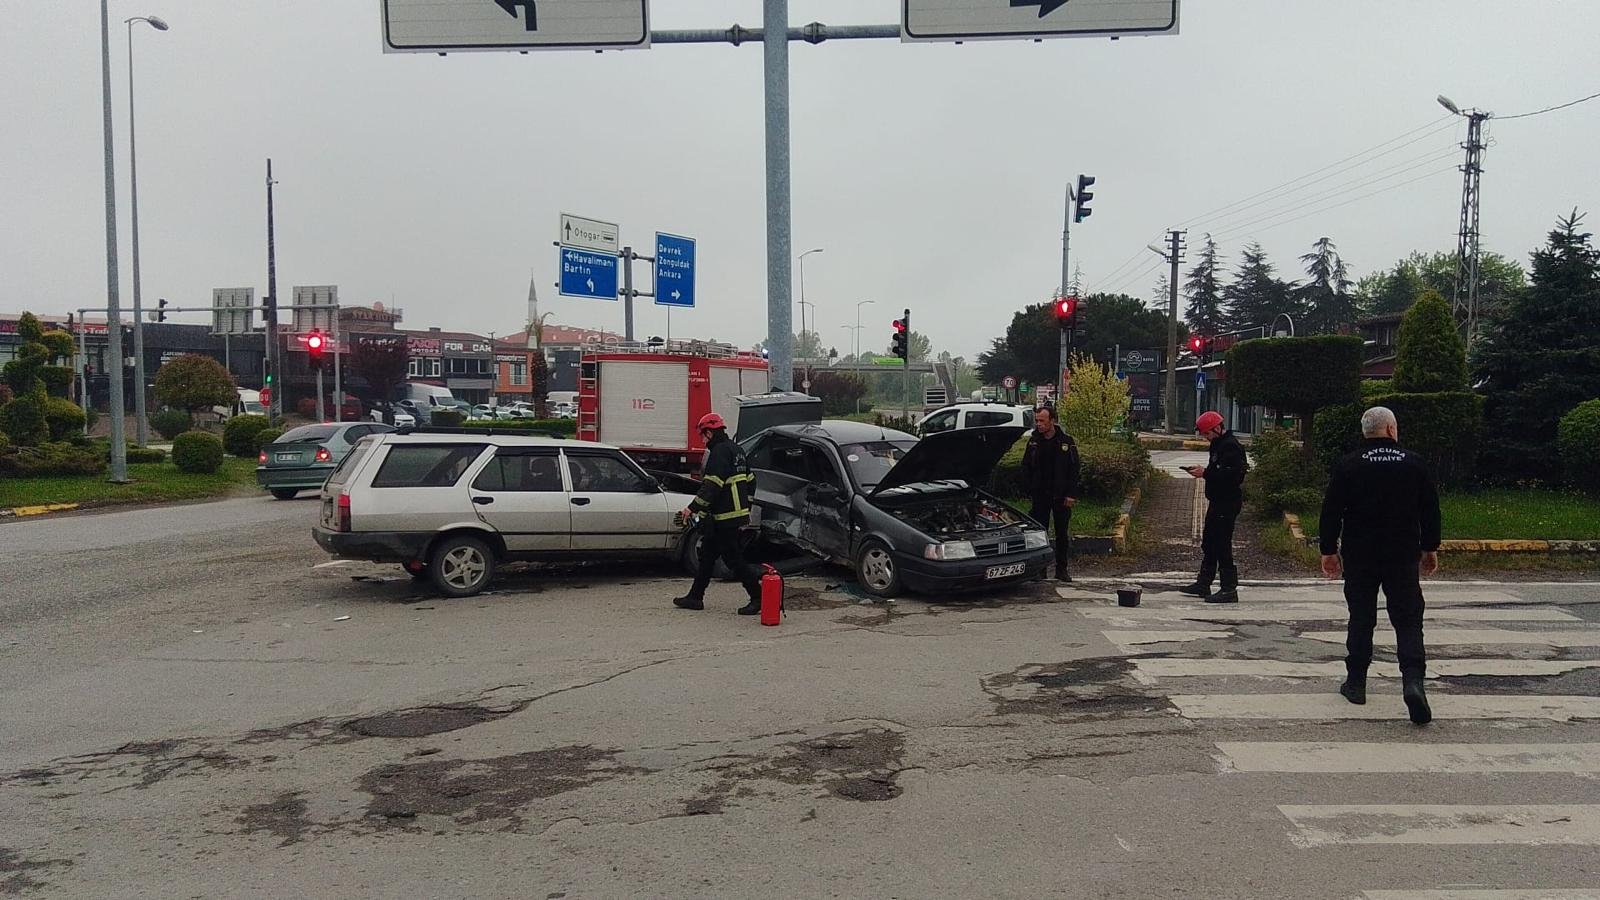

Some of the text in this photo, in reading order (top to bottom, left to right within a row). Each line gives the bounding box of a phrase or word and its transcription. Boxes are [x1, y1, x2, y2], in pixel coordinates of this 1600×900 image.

[574, 227, 600, 241] Otogar
[659, 244, 682, 256] Devrek
[573, 253, 614, 267] Havalimanı
[659, 256, 690, 269] Zonguldak
[564, 262, 591, 275] Bartın
[659, 269, 682, 279] Ankara
[444, 342, 463, 351] FOR
[1004, 378, 1015, 387] 70
[632, 398, 656, 409] 112
[989, 567, 999, 577] 67
[1000, 566, 1010, 575] ZF
